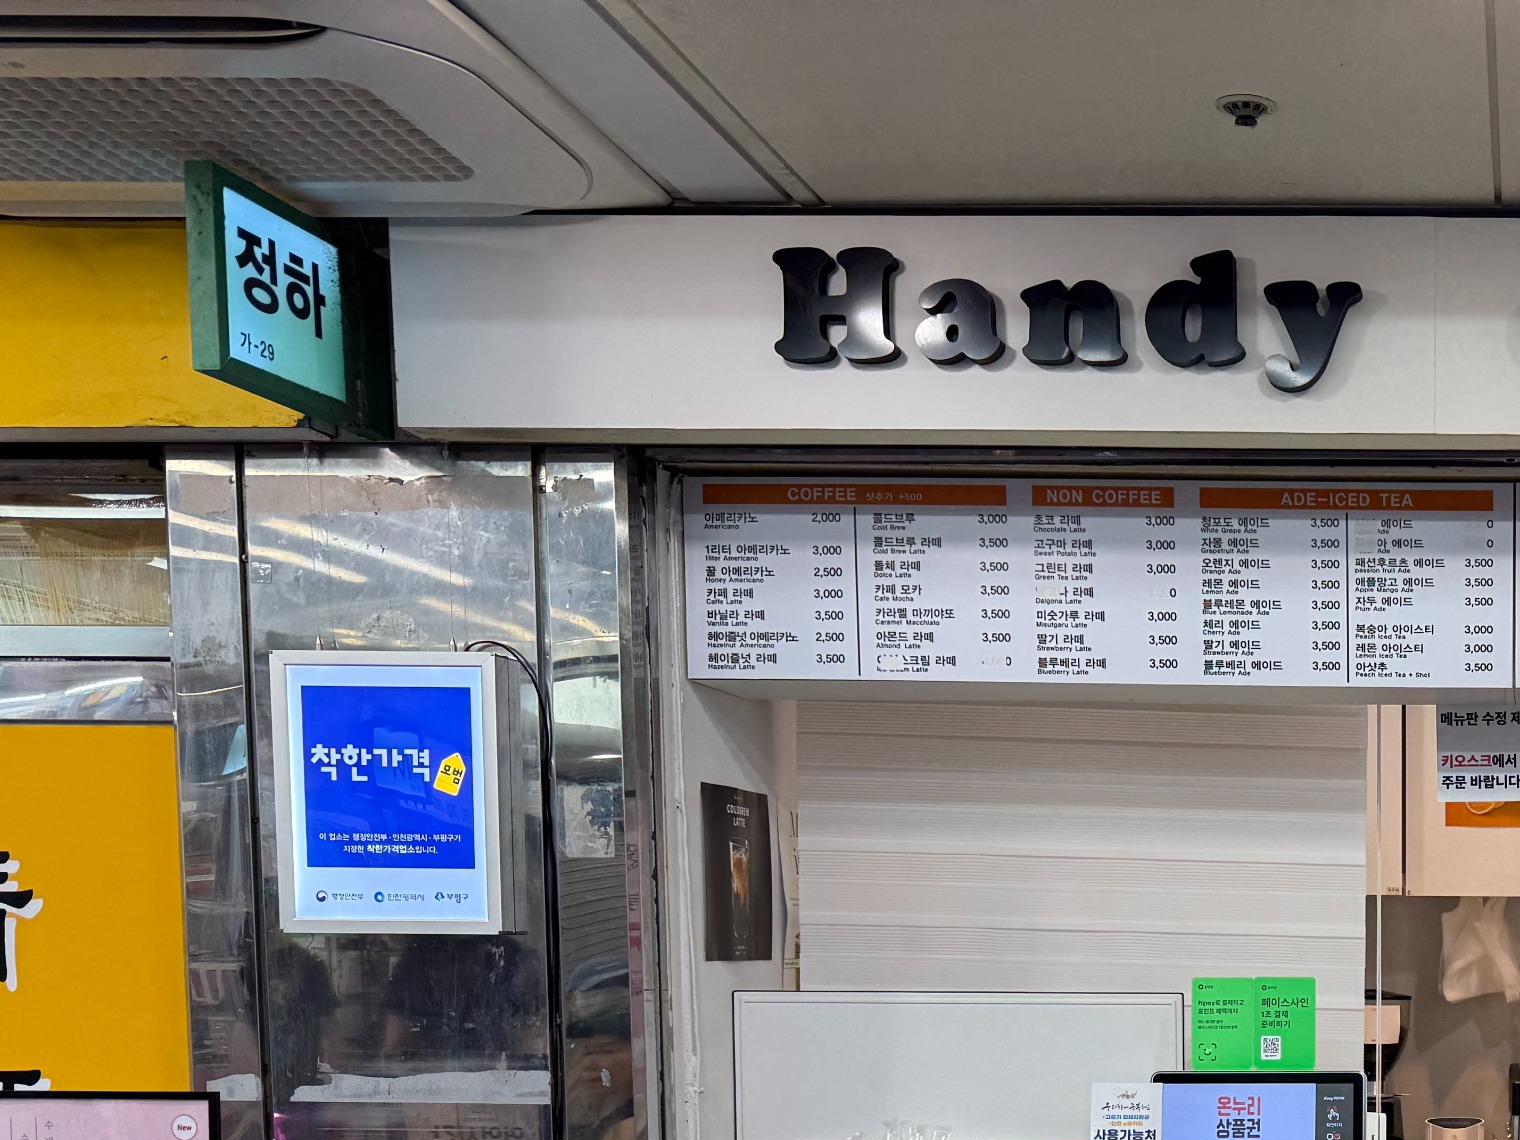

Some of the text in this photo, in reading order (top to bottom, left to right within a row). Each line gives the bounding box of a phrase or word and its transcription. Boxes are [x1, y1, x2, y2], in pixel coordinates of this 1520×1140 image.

[235, 226, 326, 340] 정하
[772, 246, 1363, 391] Handy
[240, 332, 275, 361] 가-29
[787, 488, 856, 501] COFFEE
[1047, 490, 1161, 504] NON COFFEE
[1280, 493, 1413, 507] ADE-ICED TEA
[704, 513, 841, 524] 아메리카노 2,000
[1034, 515, 1175, 527] 초코 라떼 3,000
[1201, 518, 1339, 528] 청포도 에이드 3,500
[705, 545, 842, 557] 1리터 아메리카노 3,000
[1355, 558, 1493, 569] 패션후르츠 에이드 3,500
[1441, 712, 1479, 726] 메뉴판
[1482, 712, 1507, 726] 수정
[310, 744, 430, 782] 착한가격
[1441, 754, 1517, 768] 키오스크에서
[441, 764, 463, 785] 모범
[1441, 776, 1466, 789] 주문
[329, 833, 350, 841] 업소는
[344, 845, 364, 853] 지정한
[1261, 998, 1309, 1008] 페이스사인
[1217, 1096, 1260, 1116] 온누리
[1094, 1129, 1156, 1140] 사용가능처
[1217, 1119, 1260, 1138] 상품권
